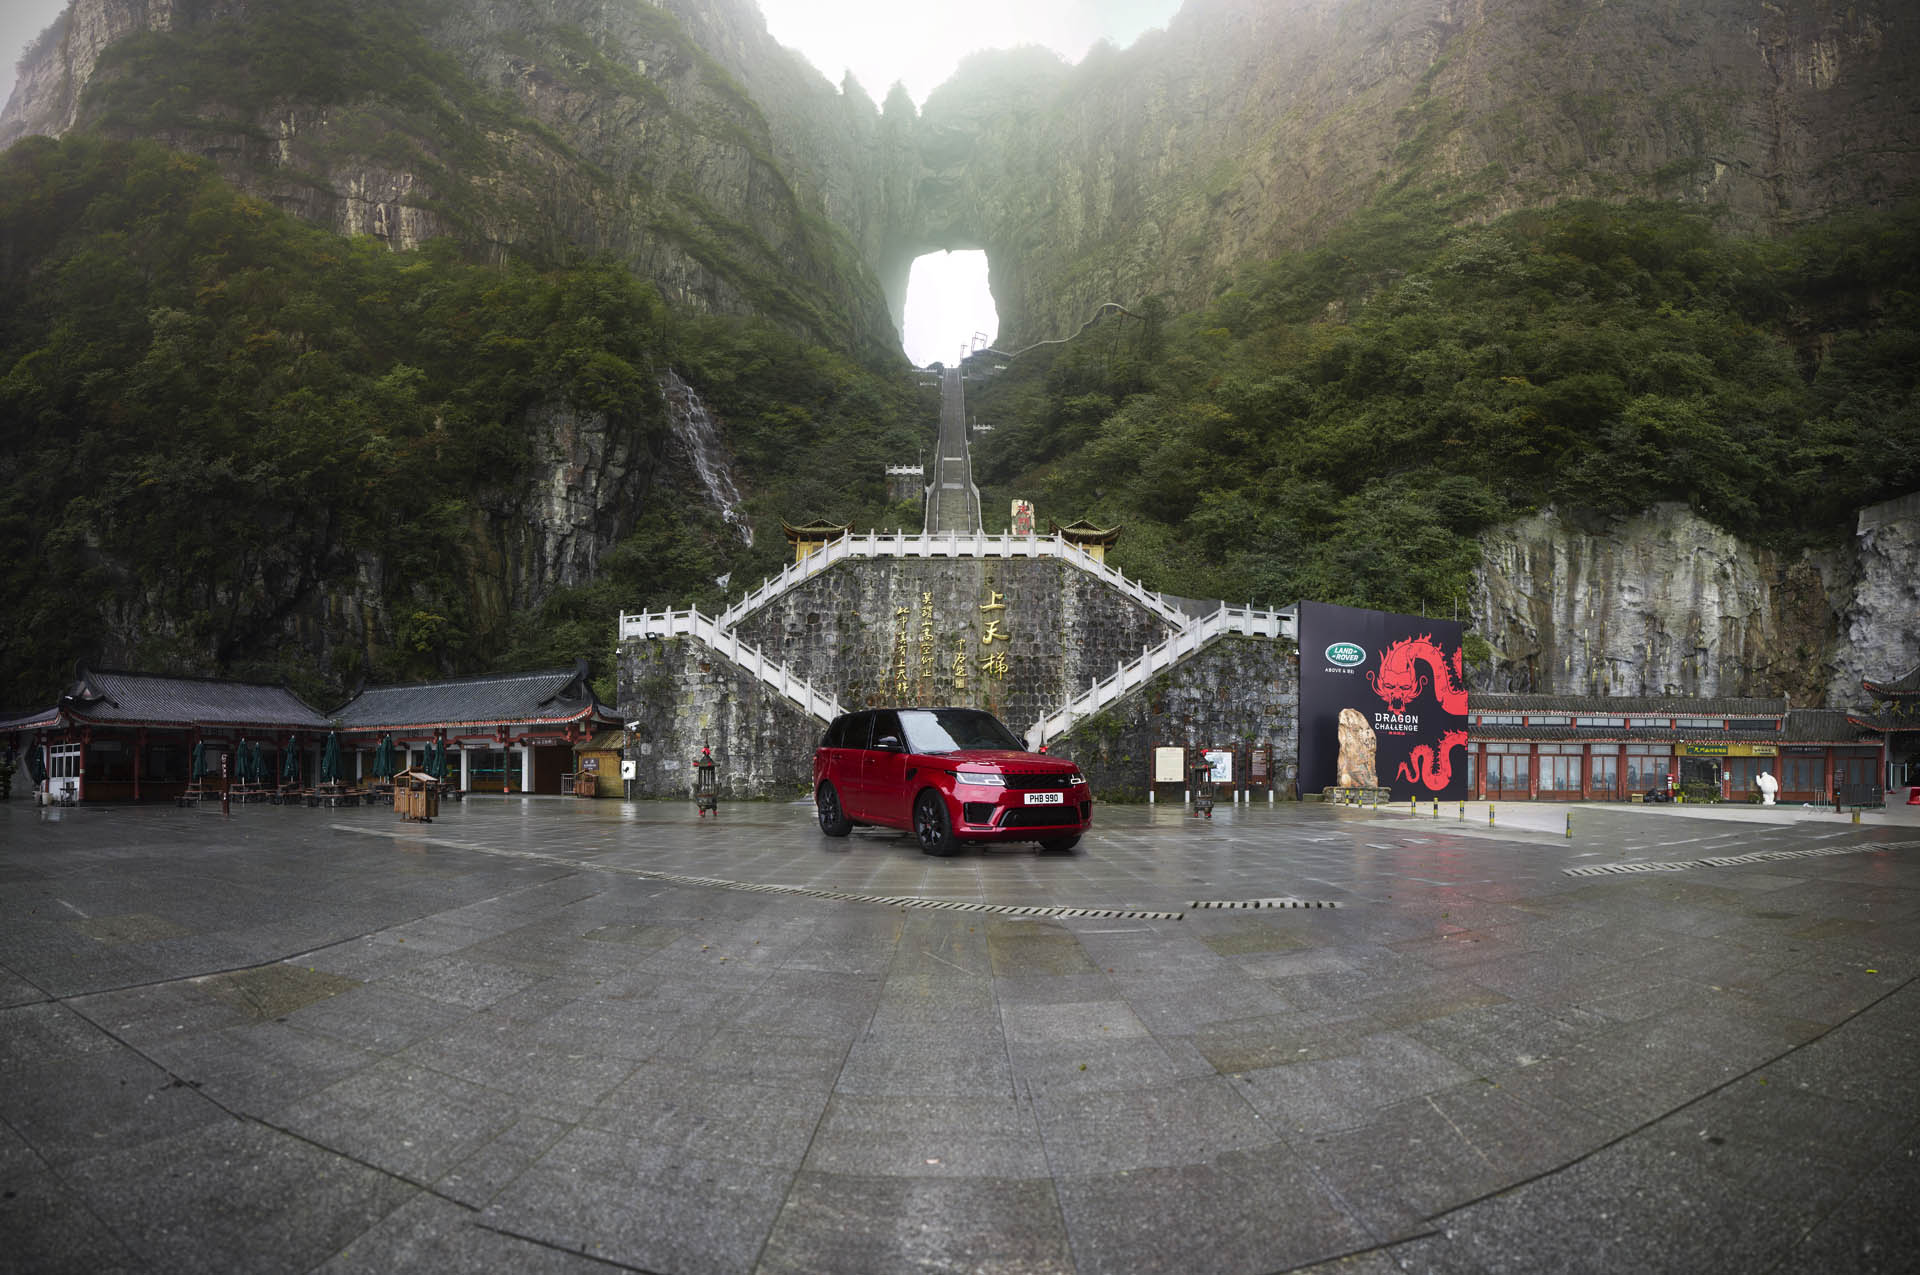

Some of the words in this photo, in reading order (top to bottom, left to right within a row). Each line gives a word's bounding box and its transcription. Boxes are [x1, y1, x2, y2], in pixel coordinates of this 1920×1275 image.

[1334, 647, 1353, 655] LAND
[1374, 713, 1418, 723] DRAGON
[1374, 723, 1418, 731] CHALLENGE
[1045, 794, 1058, 802] 990
